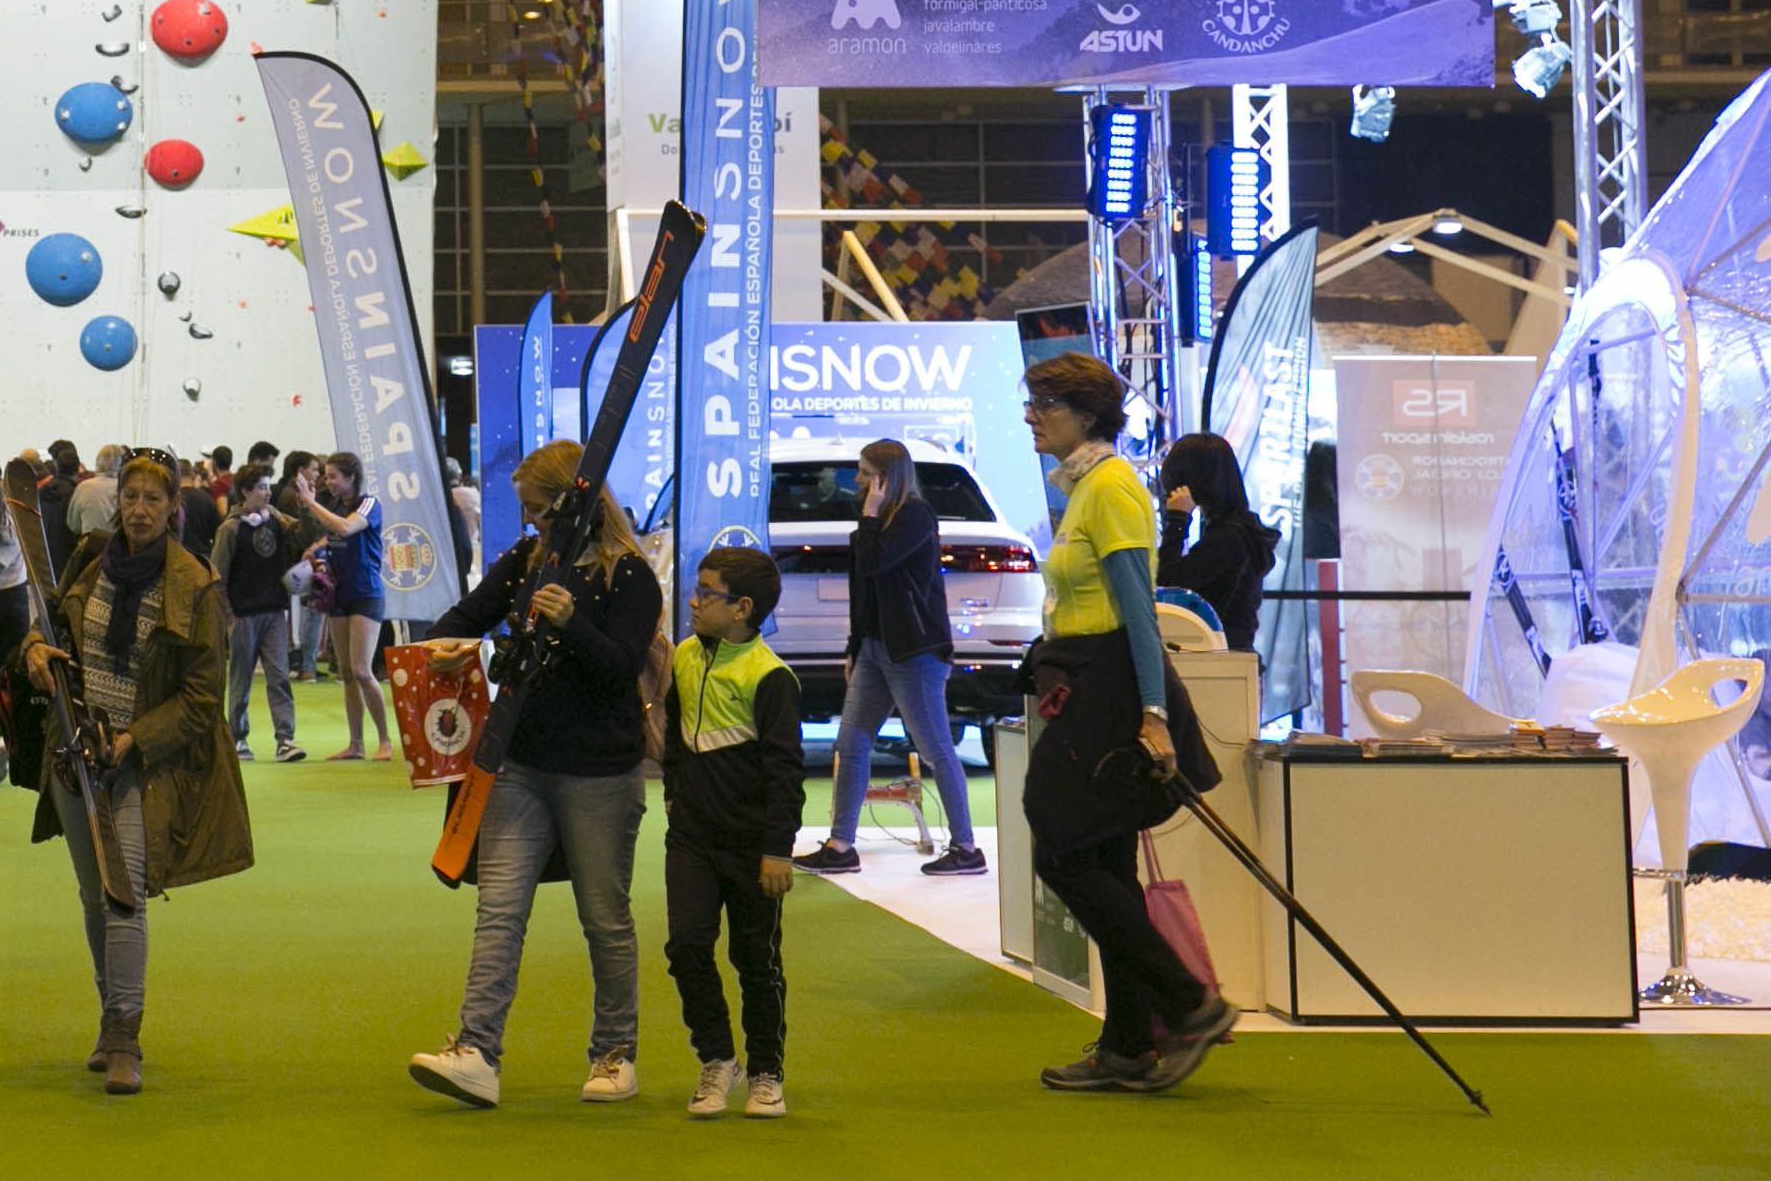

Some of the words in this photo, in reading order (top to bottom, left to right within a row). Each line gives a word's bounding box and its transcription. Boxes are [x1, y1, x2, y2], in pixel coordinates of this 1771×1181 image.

[923, 18, 996, 36] javalambre
[827, 36, 907, 55] aramon
[923, 39, 1003, 54] valdelinares
[748, 82, 765, 191] DEPORTES
[745, 203, 764, 311] ESPAÑOLA
[743, 326, 762, 451] FEDERACIÓN
[804, 396, 879, 411] DEPORTES
[881, 397, 903, 411] DE
[904, 397, 973, 411] INVIERNO
